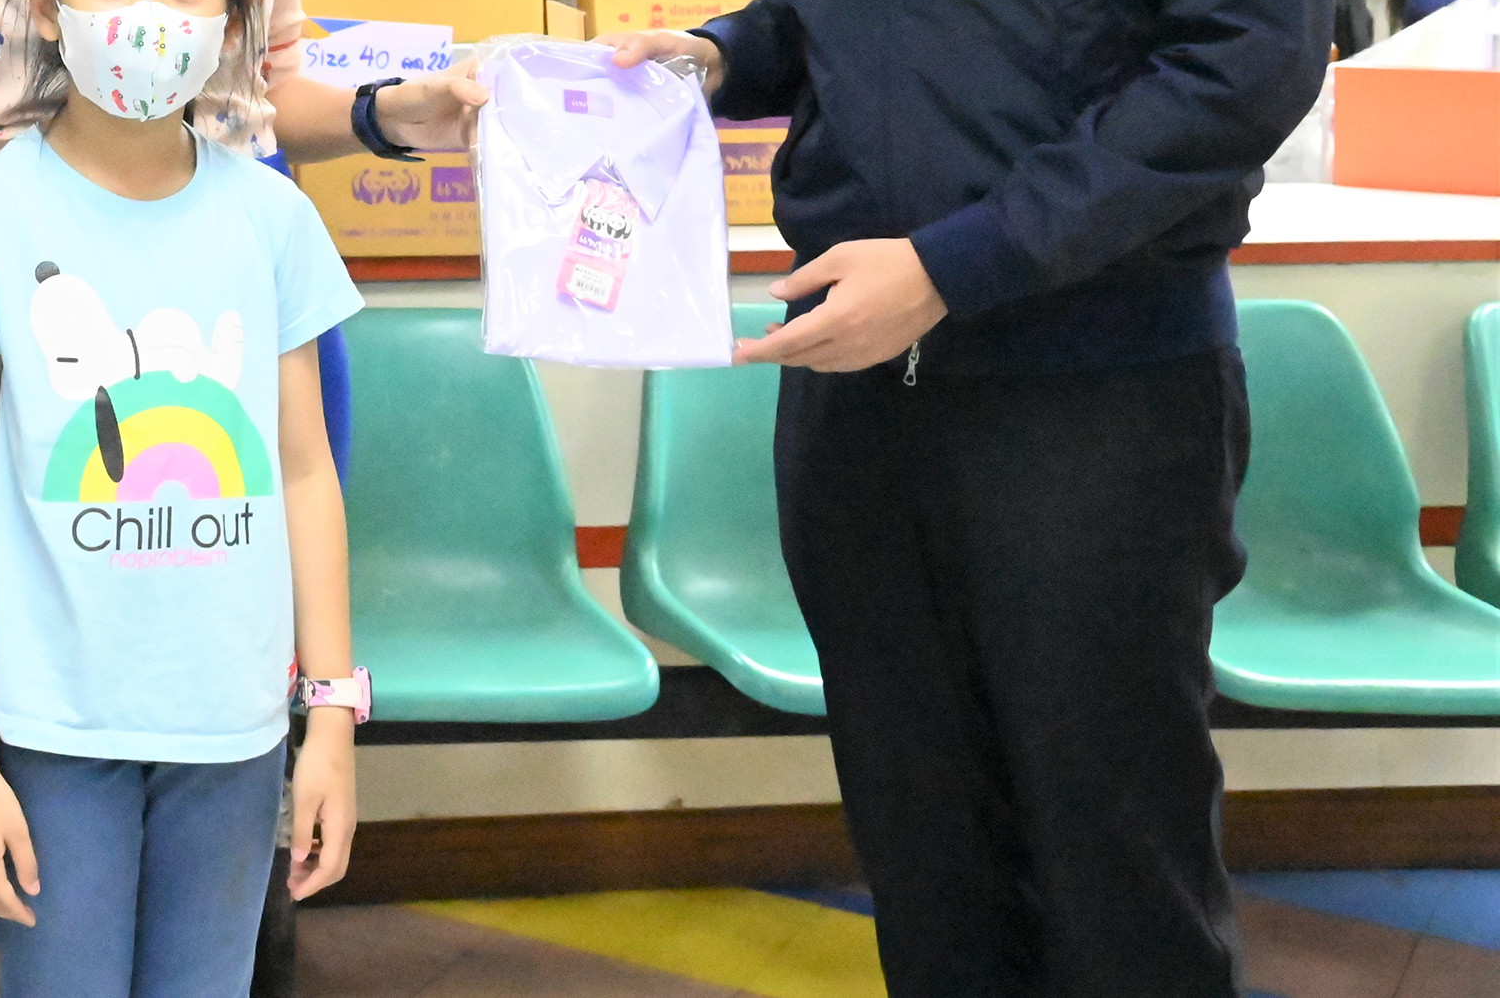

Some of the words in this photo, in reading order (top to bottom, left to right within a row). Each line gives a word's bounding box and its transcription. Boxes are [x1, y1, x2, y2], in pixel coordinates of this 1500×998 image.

[306, 42, 349, 67] Size
[360, 45, 389, 69] 40
[71, 505, 173, 552] Chill
[191, 502, 253, 549] out
